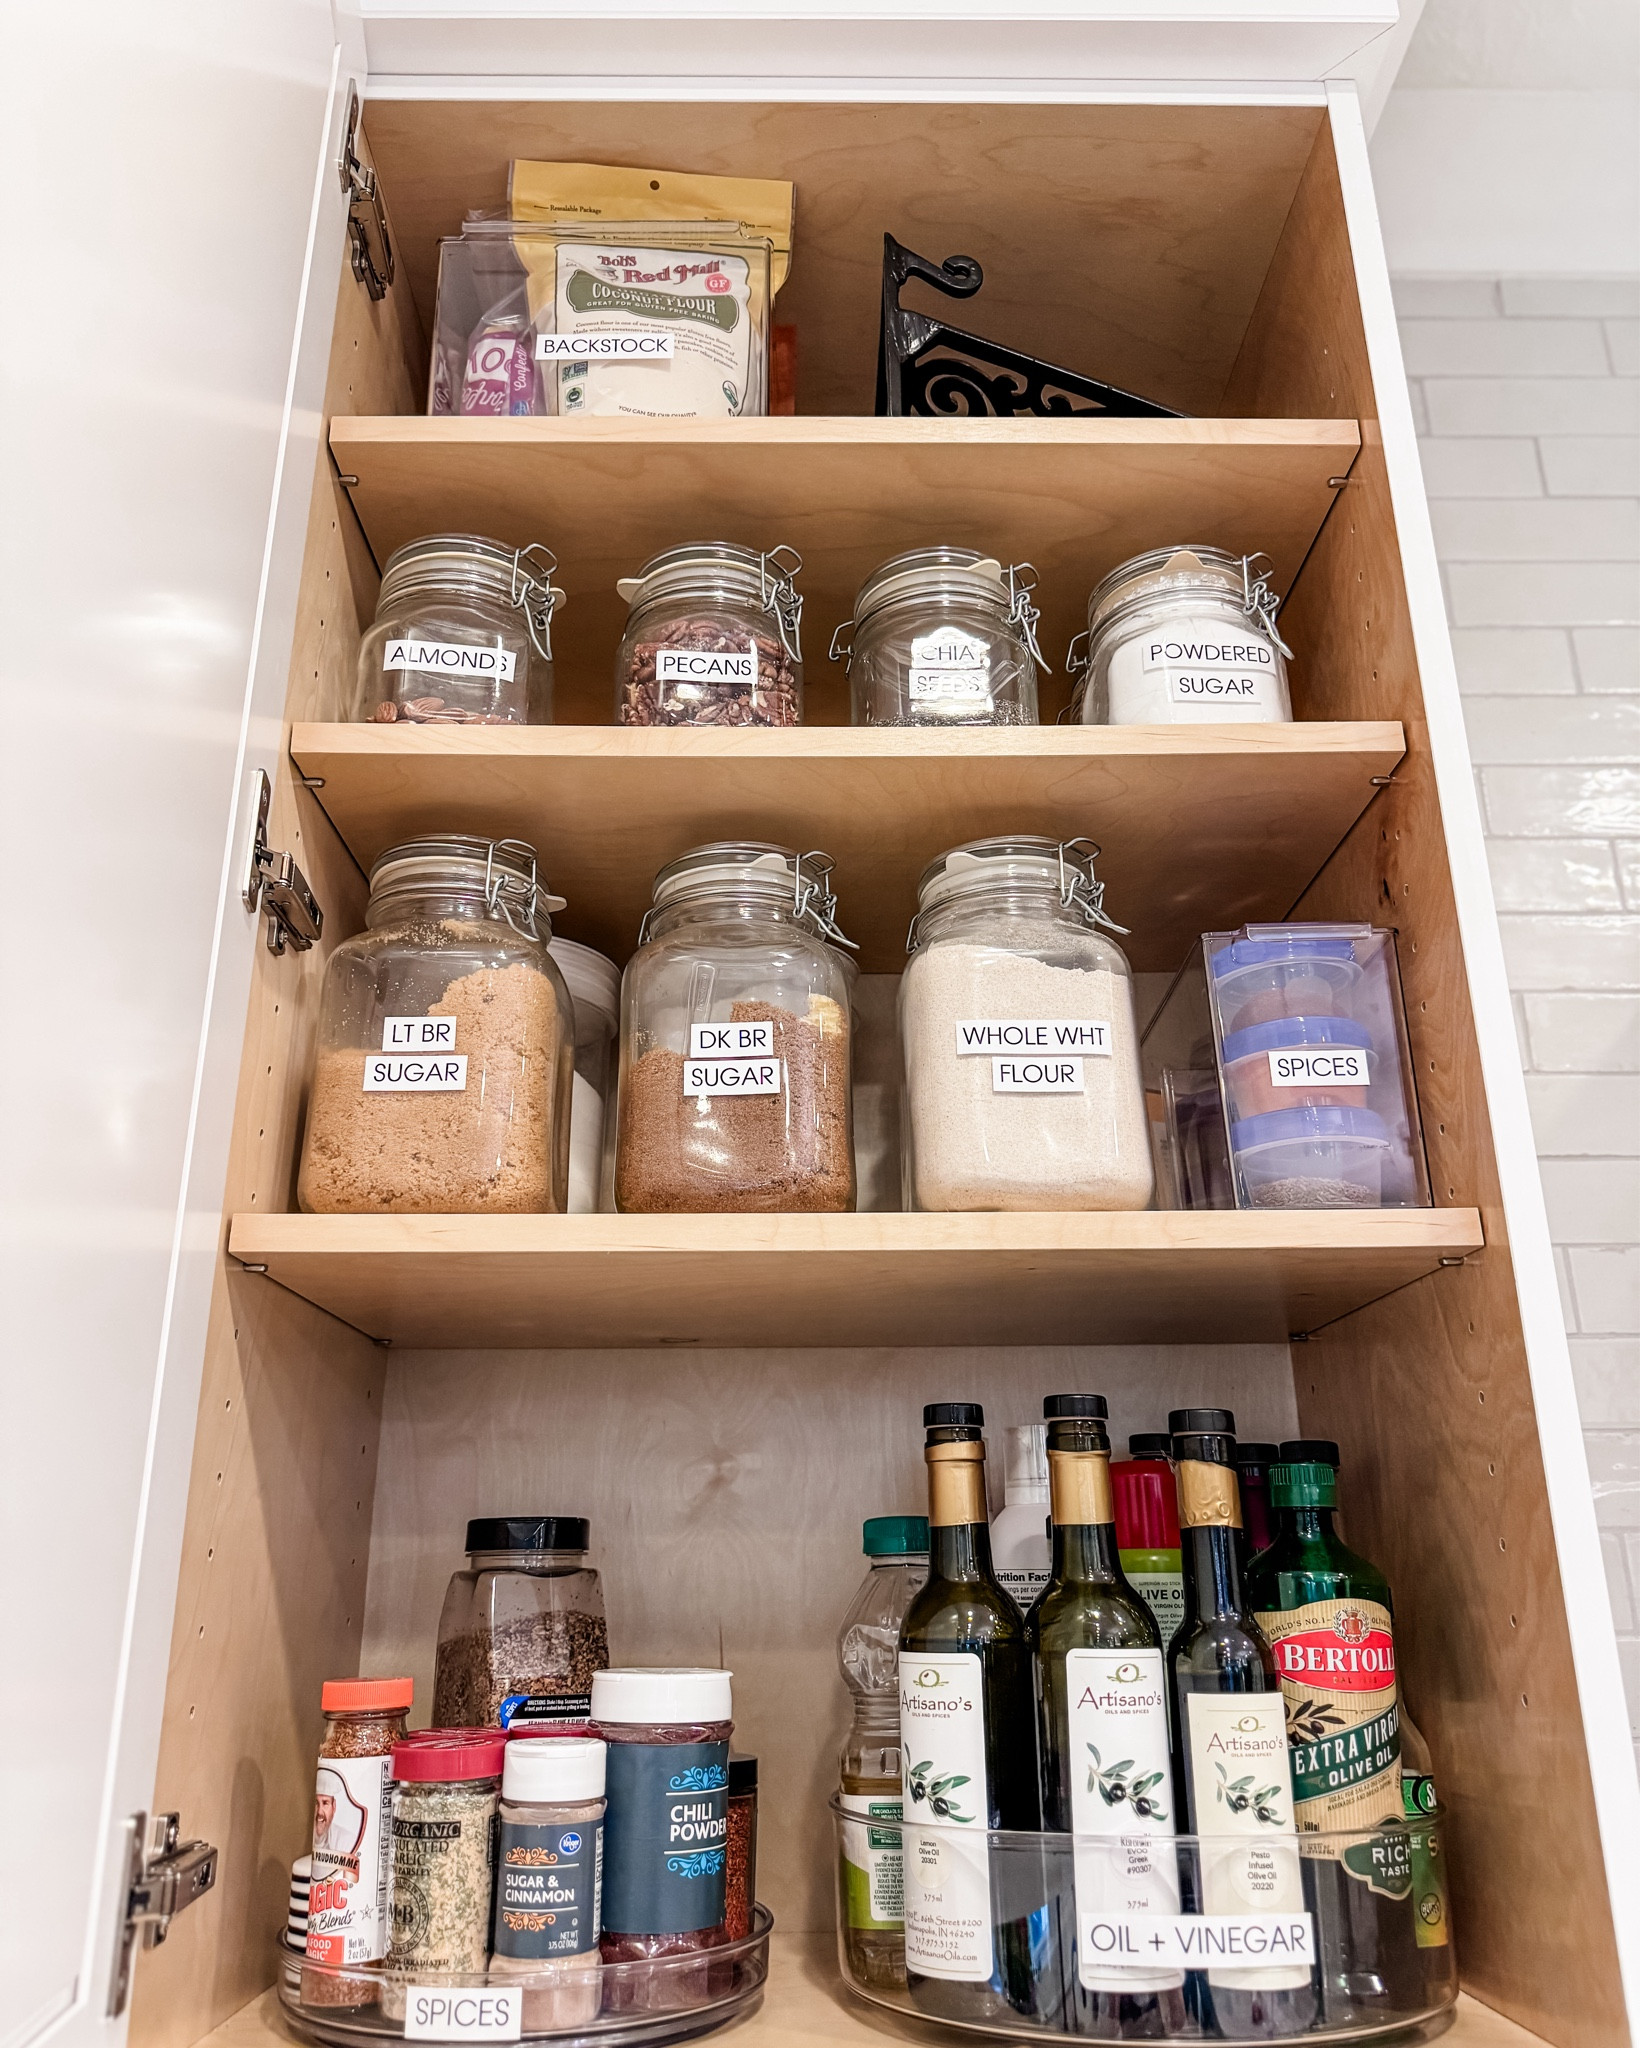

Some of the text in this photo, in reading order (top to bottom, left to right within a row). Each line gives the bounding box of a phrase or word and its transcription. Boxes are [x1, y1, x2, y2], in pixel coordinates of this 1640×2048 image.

[579, 206, 602, 215] Package
[740, 221, 756, 229] Open
[623, 260, 720, 285] Red Mill
[708, 278, 727, 289] GF
[586, 300, 612, 308] GREAT
[634, 303, 666, 312] GLUTEN
[669, 307, 689, 316] FREE
[692, 311, 720, 324] BAKING
[666, 297, 717, 316] FLOUR
[544, 339, 668, 354] BACKSTOCK
[618, 406, 630, 414] YOU
[632, 408, 646, 416] CAN
[390, 646, 508, 672] ALMONDS
[920, 645, 975, 661] CHIA
[1150, 644, 1271, 664] POWDERED
[662, 656, 752, 676] PECANS
[916, 676, 980, 692] SEEDS
[1179, 676, 1254, 696] SUGAR
[392, 1023, 452, 1044] LT BR
[700, 1028, 767, 1050] DK BR
[962, 1026, 1106, 1046] WHOLE WHT
[373, 1062, 459, 1082] SUGAR
[1000, 1064, 1075, 1084] FLOUR
[1277, 1056, 1359, 1078] SPICES
[692, 1067, 774, 1086] SUGAR
[1140, 1590, 1168, 1600] LIVE
[900, 1690, 972, 1712] Artisano's
[1077, 1686, 1162, 1710] Artisano's
[1206, 1732, 1284, 1754] Artisano's
[1294, 1734, 1359, 1775] EXTRA
[1328, 1757, 1373, 1787] OLIVE
[1376, 1746, 1392, 1768] OIL
[670, 1802, 712, 1823] CHILI
[394, 1822, 460, 1838] ORGANIC
[670, 1817, 727, 1842] POWDER
[563, 1836, 579, 1850] Kroger
[315, 1852, 359, 1870] PRUDHOMME
[1129, 1856, 1148, 1864] Greek
[1251, 1851, 1270, 1859] Pesto
[398, 1868, 431, 1876] PARSLEY
[1127, 1865, 1152, 1874] #90307
[1248, 1861, 1274, 1869] Infused
[1380, 1864, 1410, 1877] TASTE
[506, 1874, 559, 1888] SUGAR &
[1248, 1872, 1277, 1880] Olive Oil
[1252, 1882, 1274, 1890] 20220
[505, 1888, 575, 1903] CINNAMON
[318, 1910, 352, 1931] Blends
[935, 1916, 960, 1926] Street
[560, 1930, 578, 1940] NET WT
[938, 1927, 948, 1938] IN
[1090, 1924, 1306, 1954] OIL + VINEGAR
[348, 1939, 357, 1948] Net
[558, 1940, 566, 1948] OZ
[348, 1950, 352, 1960] 2
[415, 1998, 510, 2026] SPICES
